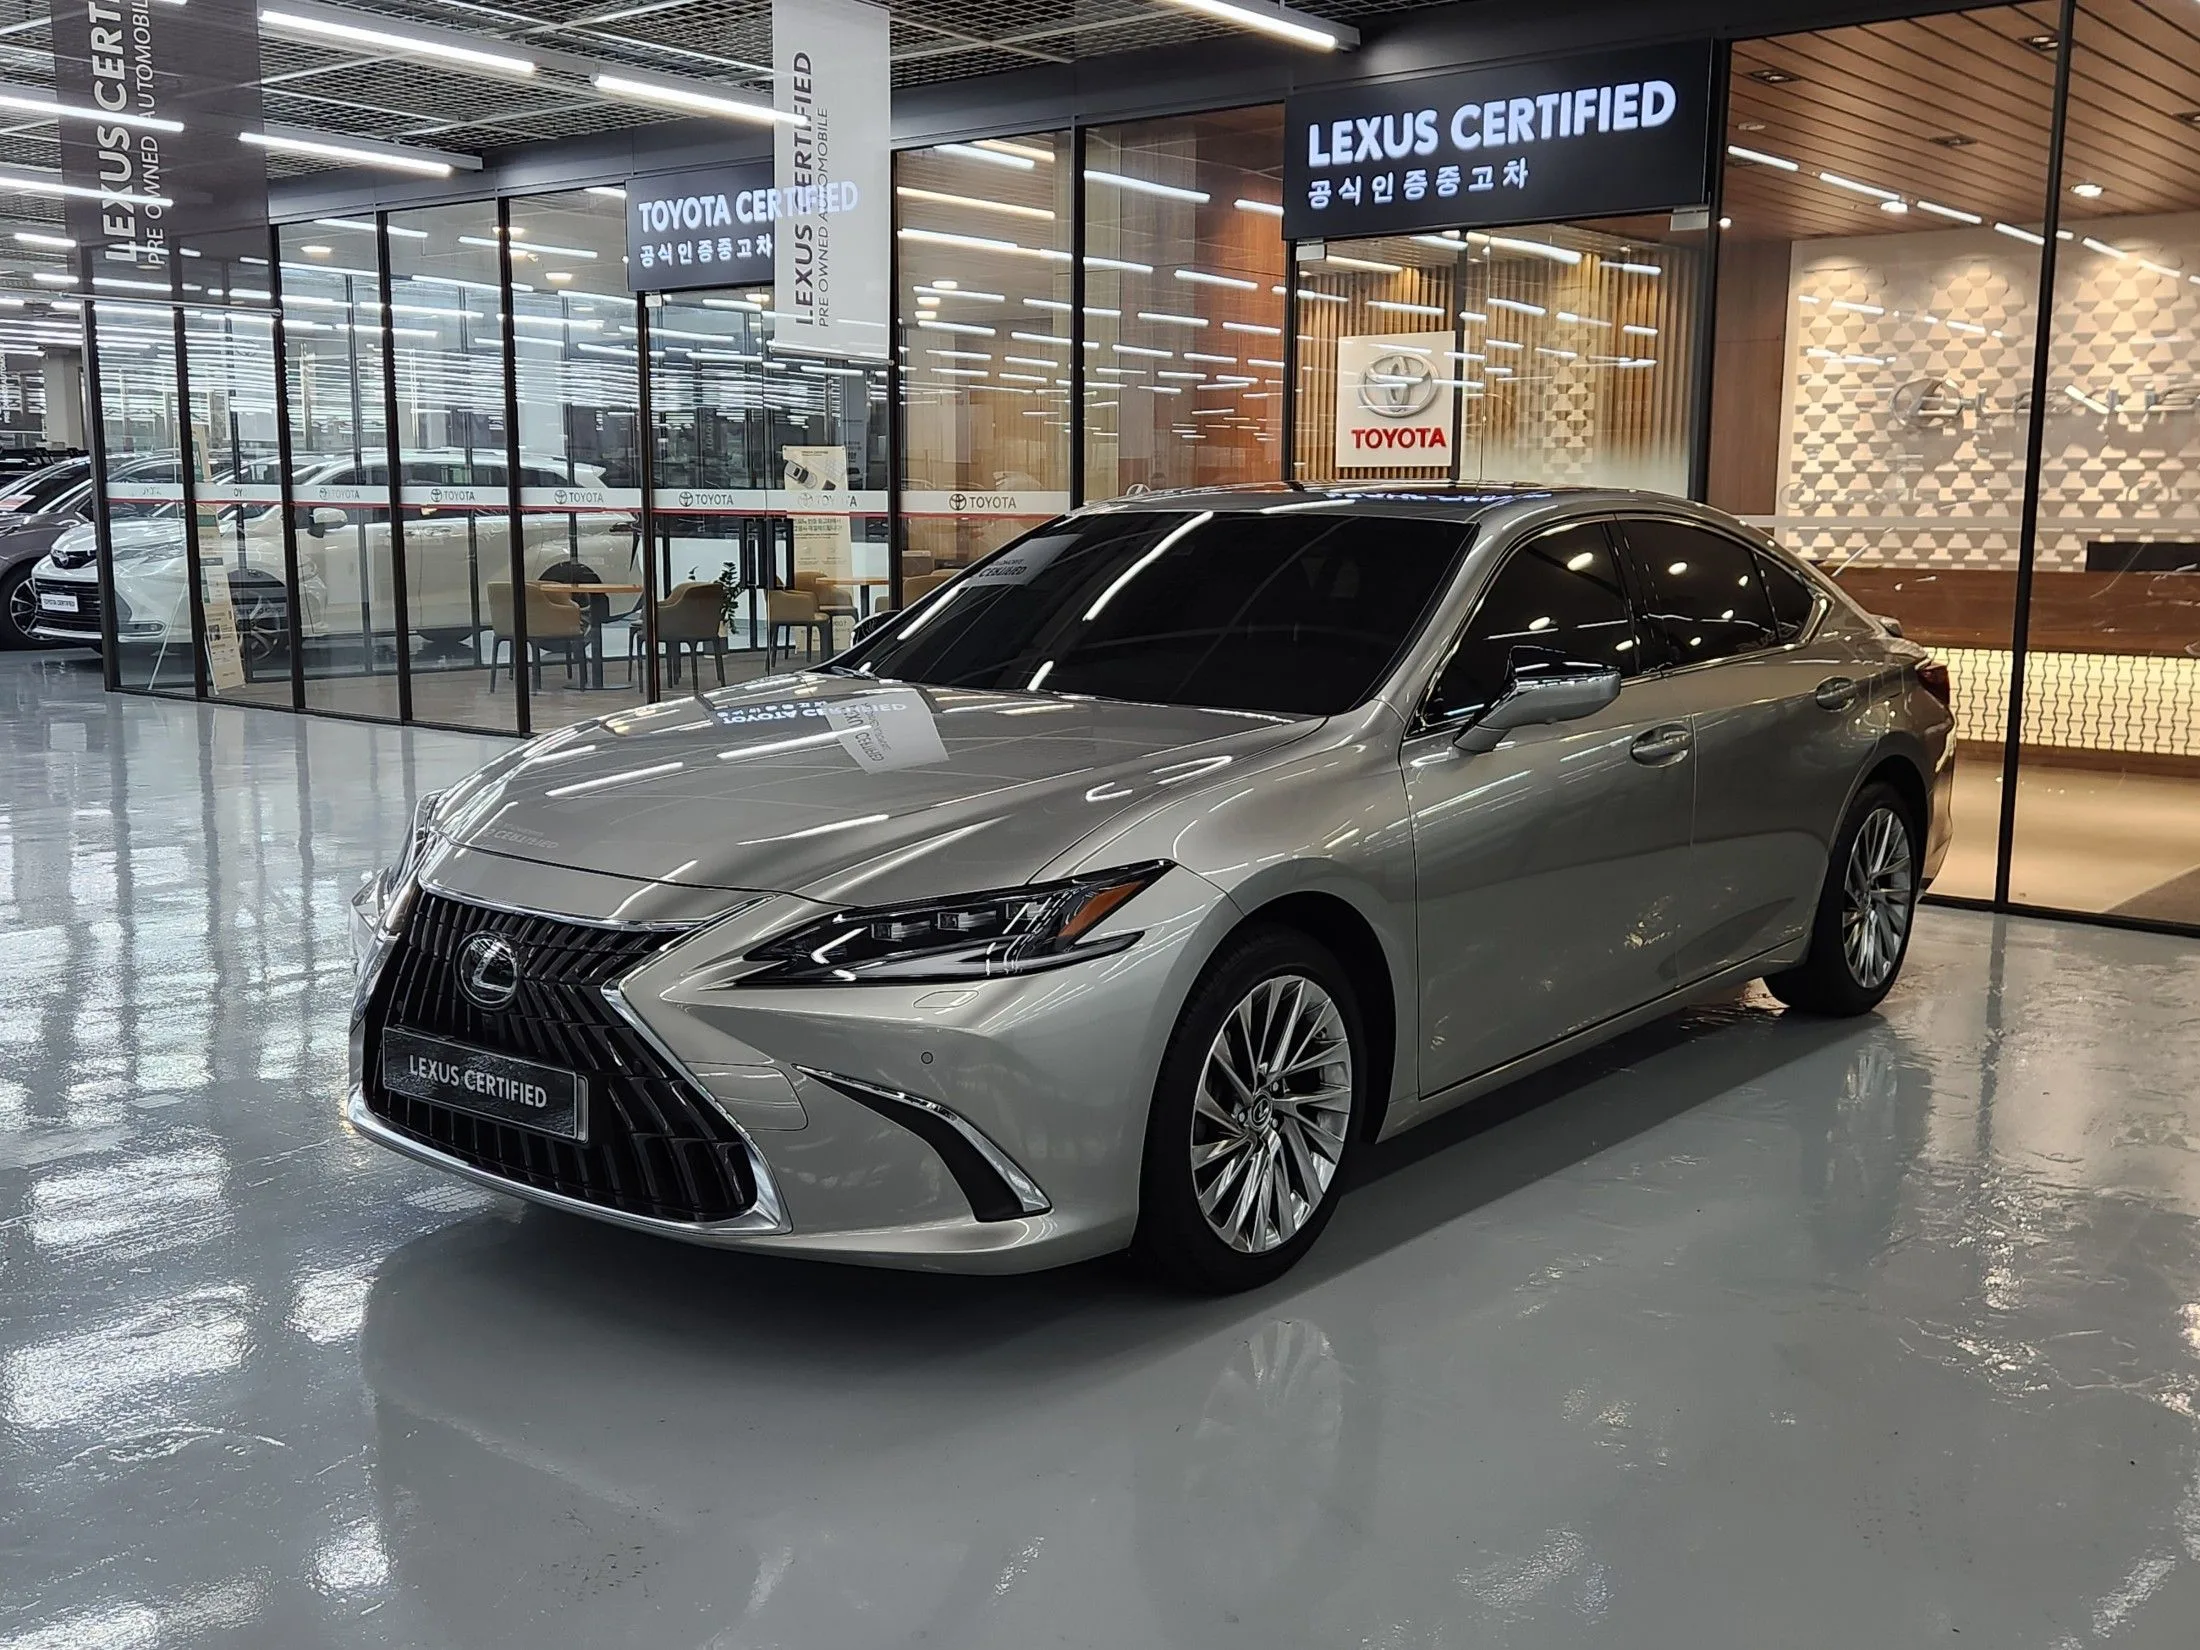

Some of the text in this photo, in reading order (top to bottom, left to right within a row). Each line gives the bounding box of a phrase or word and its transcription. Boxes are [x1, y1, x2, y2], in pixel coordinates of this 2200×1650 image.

[88, 0, 138, 262] LEXUS CERT
[1308, 80, 1677, 168] LEXUS CERTIFIED
[140, 136, 162, 219] OWNED
[1308, 157, 1529, 210] 공식인증중고차
[638, 180, 859, 233] TOYOTA CERTIFIED
[146, 228, 166, 265] PRE
[818, 226, 829, 292] OWNED
[794, 223, 813, 326] LEXUS
[818, 297, 829, 327] PRE
[1350, 427, 1447, 449] TOYOTA
[443, 490, 475, 502] TOYOTA
[568, 491, 604, 504] TOYOTA
[695, 493, 734, 506] TOYOTA
[968, 495, 1017, 510] TOYOTA
[409, 1054, 547, 1109] LEXUS CERTIFIED
